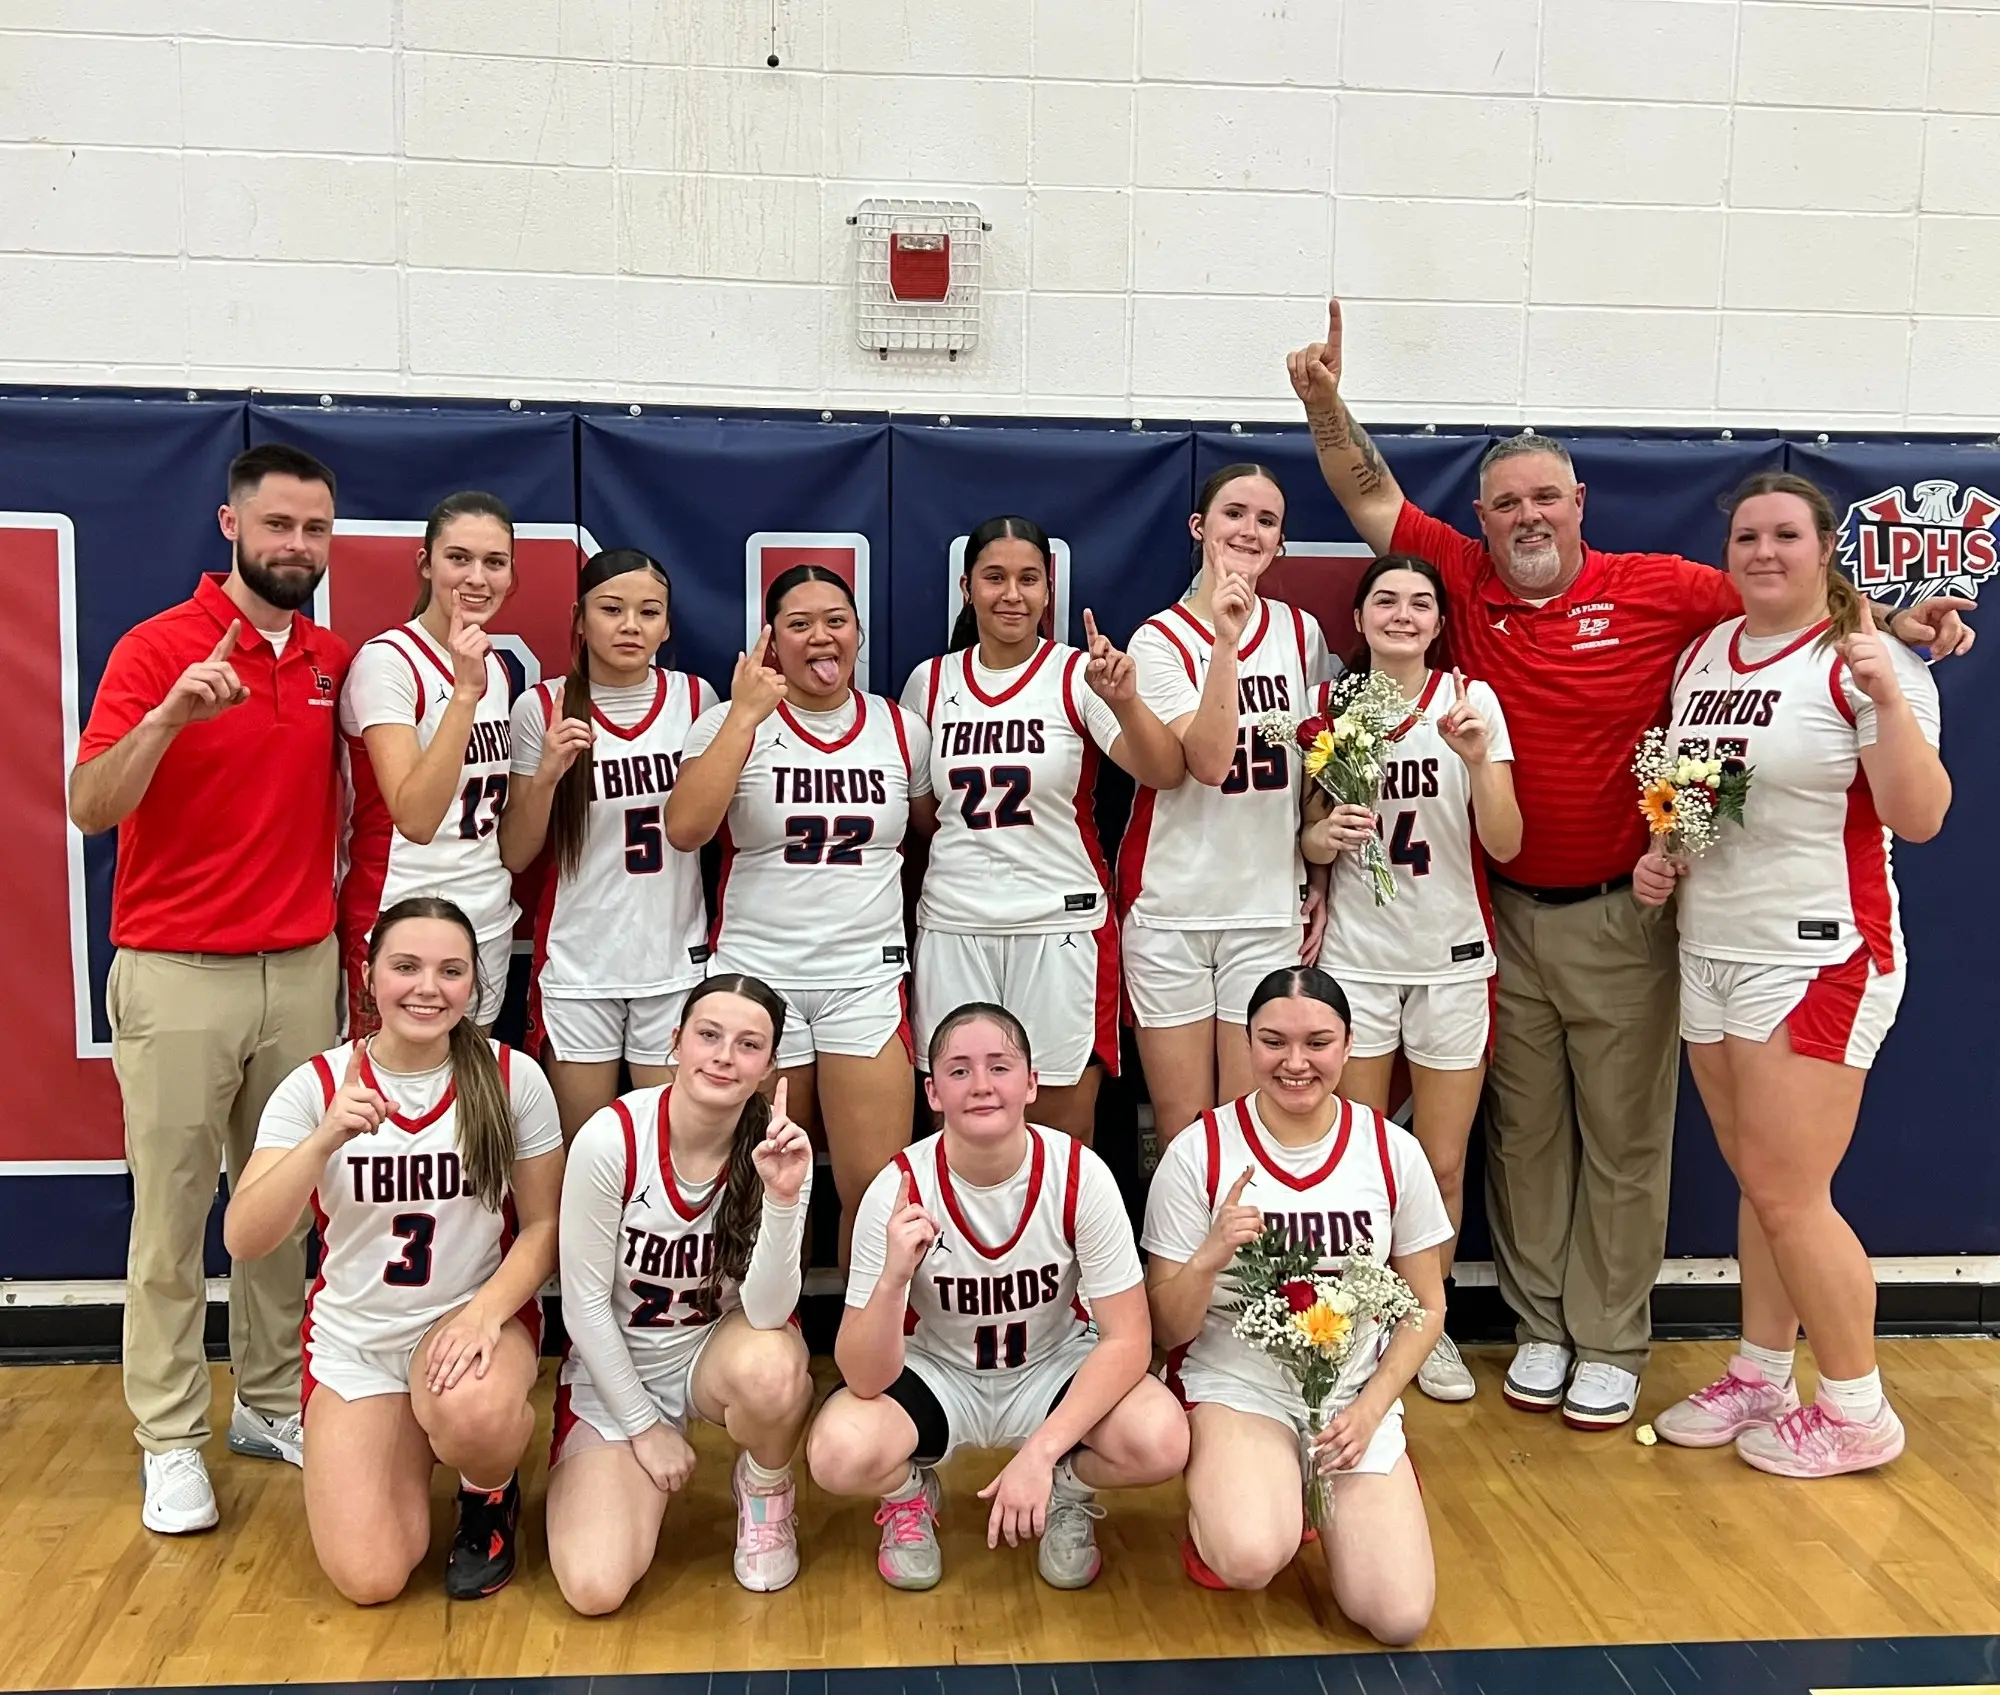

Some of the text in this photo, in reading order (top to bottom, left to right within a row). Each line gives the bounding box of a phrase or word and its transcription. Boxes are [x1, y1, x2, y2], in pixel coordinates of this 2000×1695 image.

[1859, 524, 1997, 584] LPHS
[1576, 617, 1610, 637] LP
[309, 665, 333, 700] LP
[1678, 689, 1782, 727] TBIRDS
[941, 719, 1045, 758] TBIRDS
[459, 773, 509, 839] 13
[772, 766, 887, 804] TBIRDS
[948, 766, 1034, 830] 22
[625, 805, 663, 875] 5
[784, 815, 875, 866] 32
[347, 1152, 477, 1203] TBIRD
[383, 1212, 436, 1287] 3
[624, 1226, 718, 1279] TBIRD
[1263, 1210, 1374, 1257] BIRDS
[628, 1279, 723, 1327] 23
[933, 1263, 1060, 1316] TBIRDS
[973, 1320, 1027, 1370] 11
